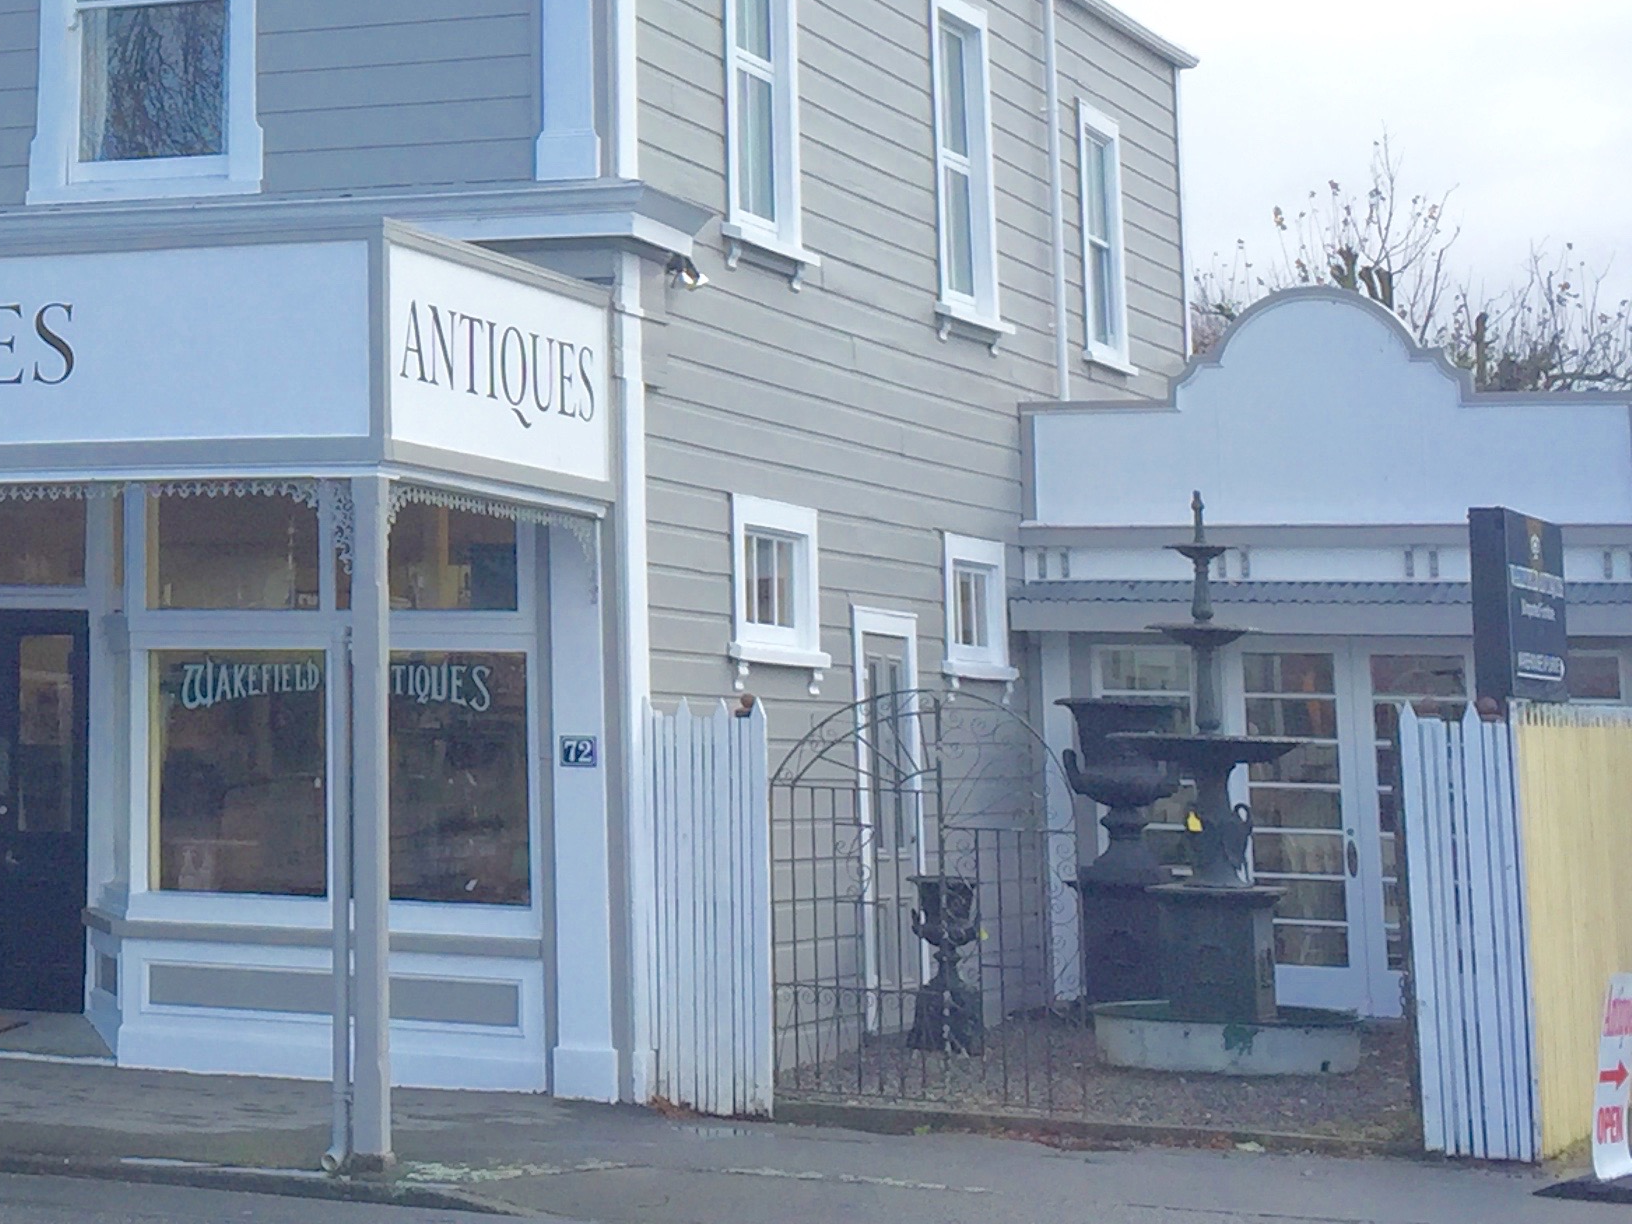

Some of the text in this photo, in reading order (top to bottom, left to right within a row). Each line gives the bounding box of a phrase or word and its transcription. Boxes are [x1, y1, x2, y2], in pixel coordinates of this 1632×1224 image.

[400, 299, 596, 429] ANTIQUES
[181, 656, 491, 713] WAKEFIELD TIQUES
[564, 740, 592, 762] 72
